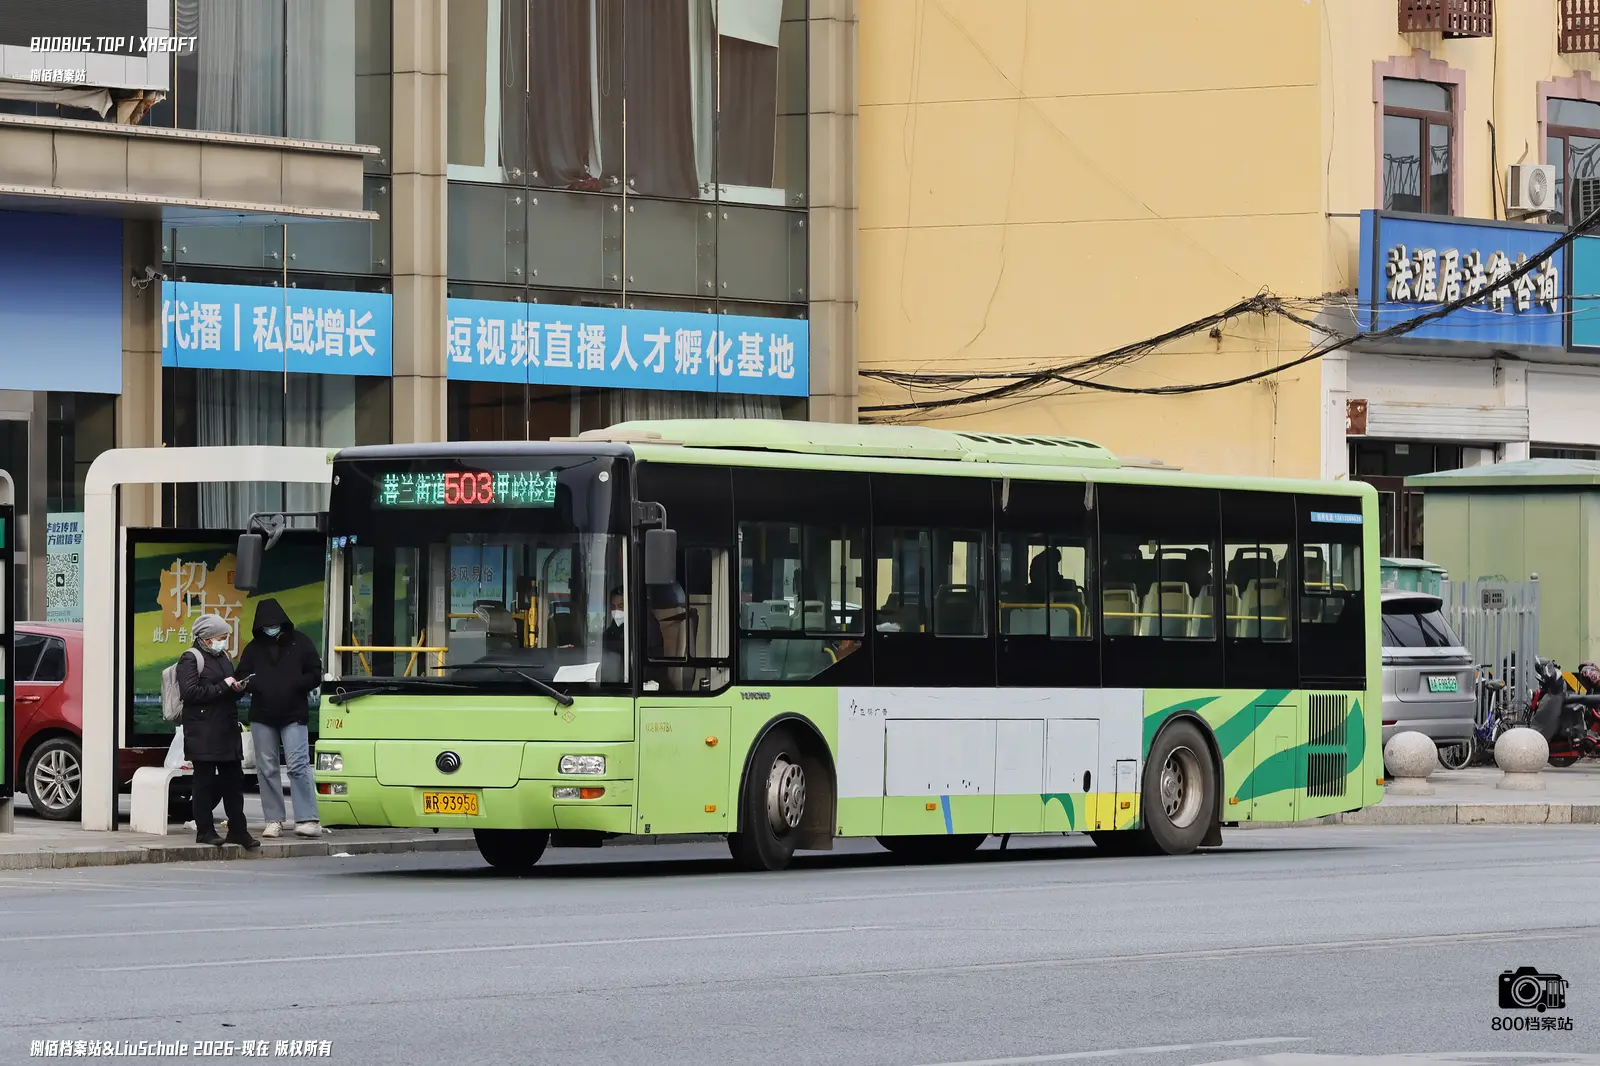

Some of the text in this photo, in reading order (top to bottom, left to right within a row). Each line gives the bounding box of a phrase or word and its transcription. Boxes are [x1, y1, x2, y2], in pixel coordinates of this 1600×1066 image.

[447, 316, 796, 380] 短视频直播人才孵化基地
[445, 472, 493, 505] 503
[492, 472, 557, 505] 甲岭检查
[47, 534, 82, 545] 方微信号
